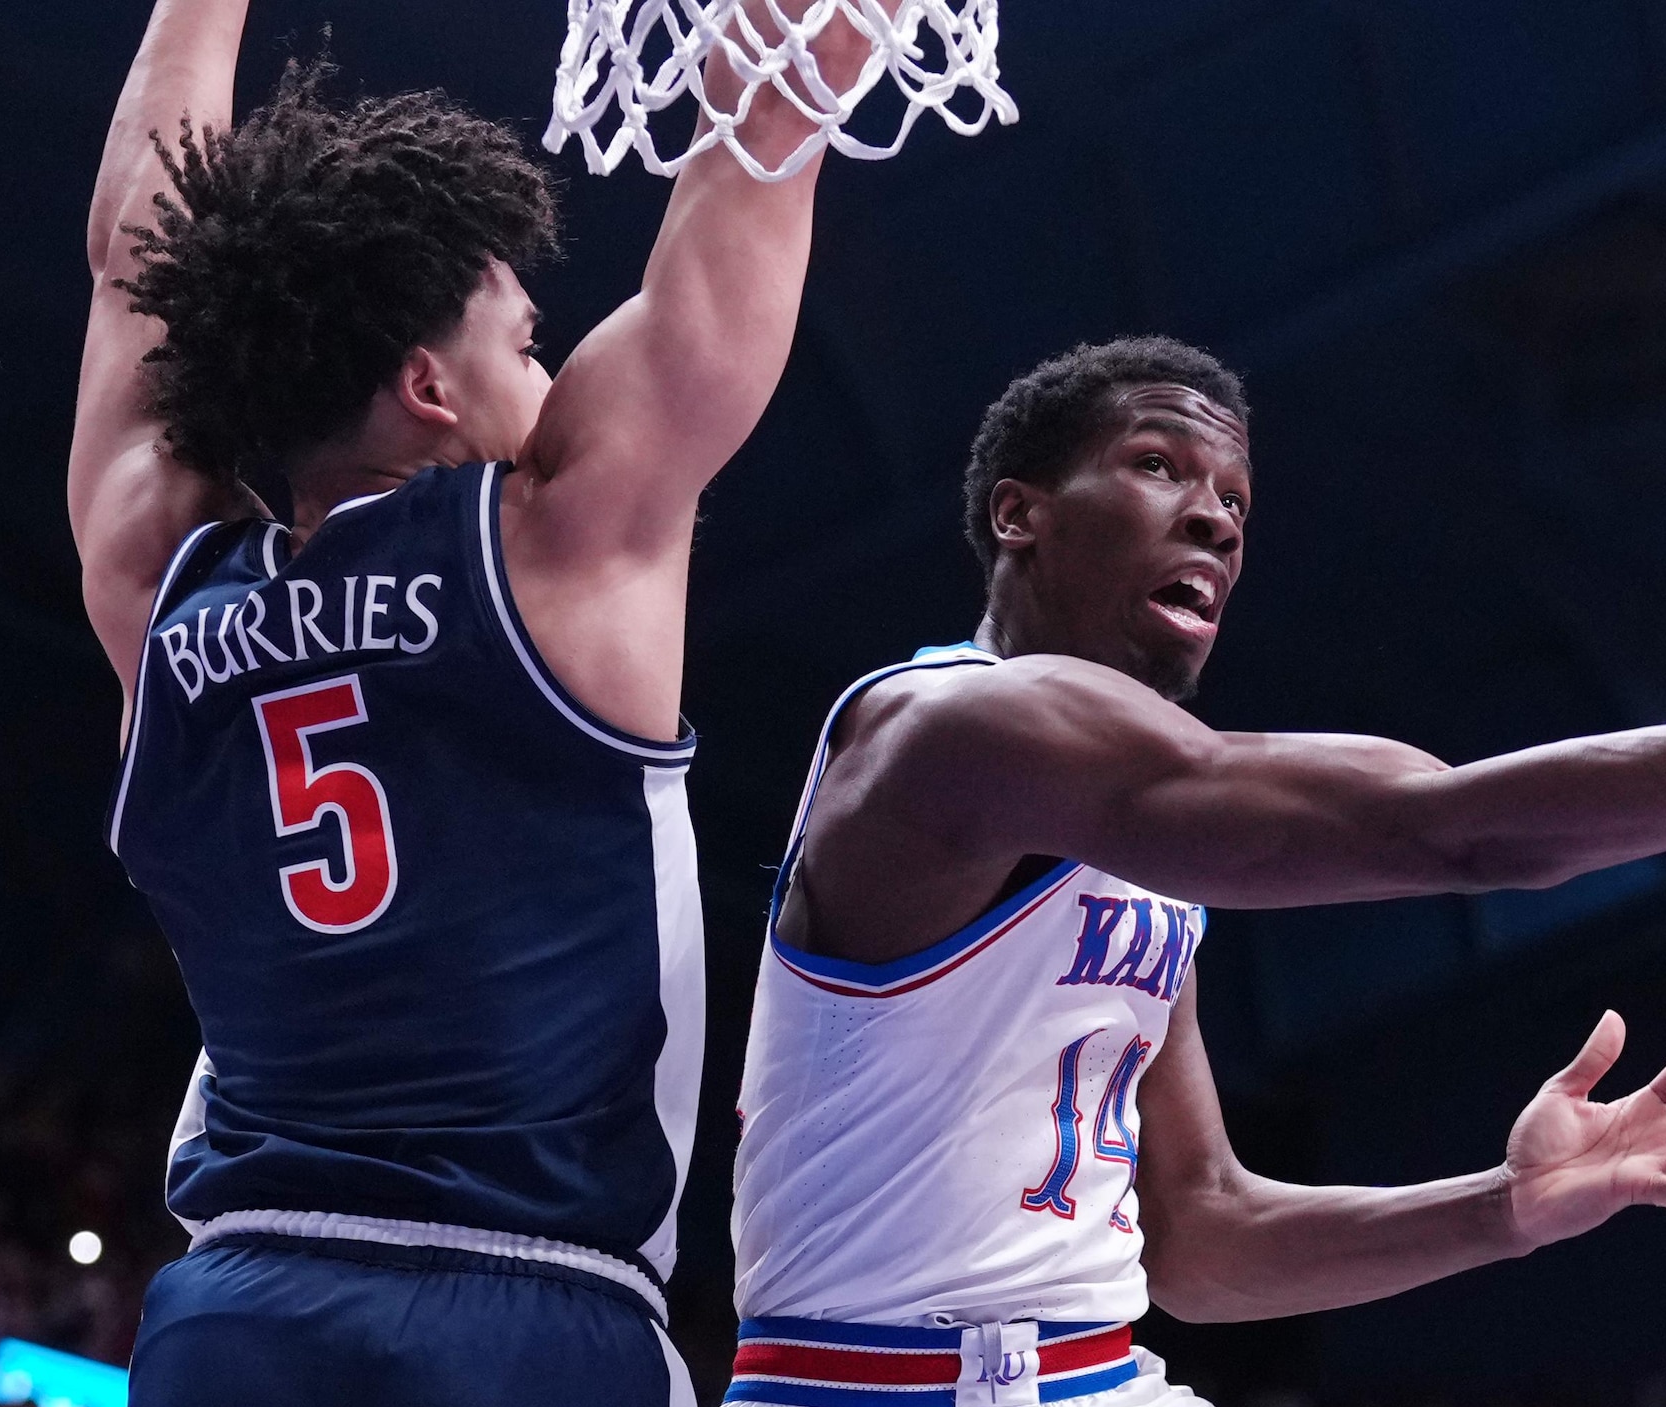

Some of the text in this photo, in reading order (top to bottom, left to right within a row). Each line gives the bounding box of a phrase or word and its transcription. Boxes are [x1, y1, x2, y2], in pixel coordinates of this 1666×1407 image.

[159, 573, 443, 704] BURRIES
[251, 673, 399, 935] 5
[1020, 1028, 1152, 1234] 14
